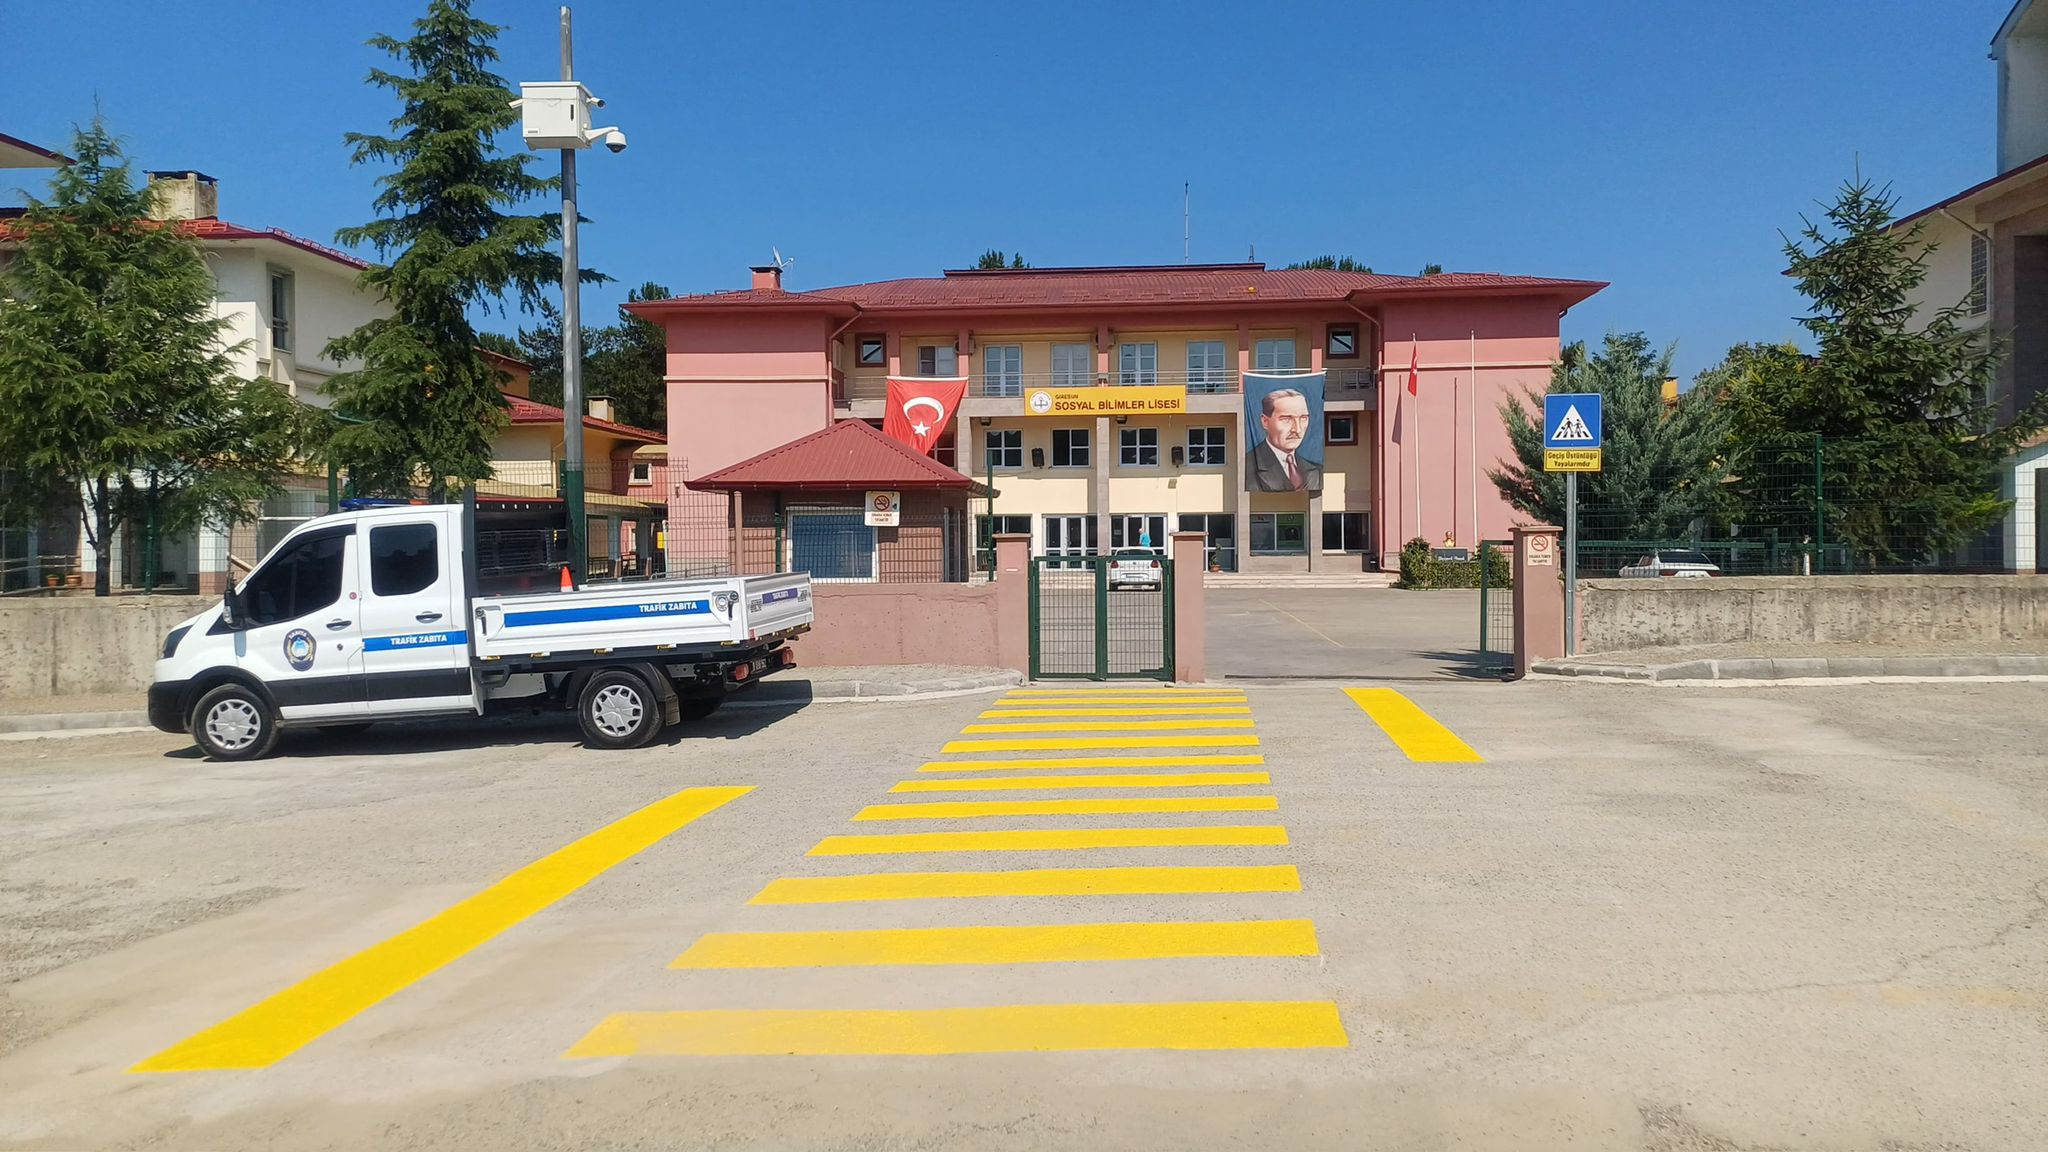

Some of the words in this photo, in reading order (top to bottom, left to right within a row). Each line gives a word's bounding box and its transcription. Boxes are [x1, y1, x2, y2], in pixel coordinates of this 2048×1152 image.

[1055, 401, 1094, 411] SOSYAL
[1099, 400, 1145, 410] BİLİMLER
[1149, 398, 1180, 409] LİSESİ
[1548, 452, 1565, 460] Geçiş
[639, 603, 667, 612] TRAFİK
[668, 602, 697, 611] ZABITA
[391, 635, 417, 645] TRAFİK
[418, 634, 447, 644] ZABITA
